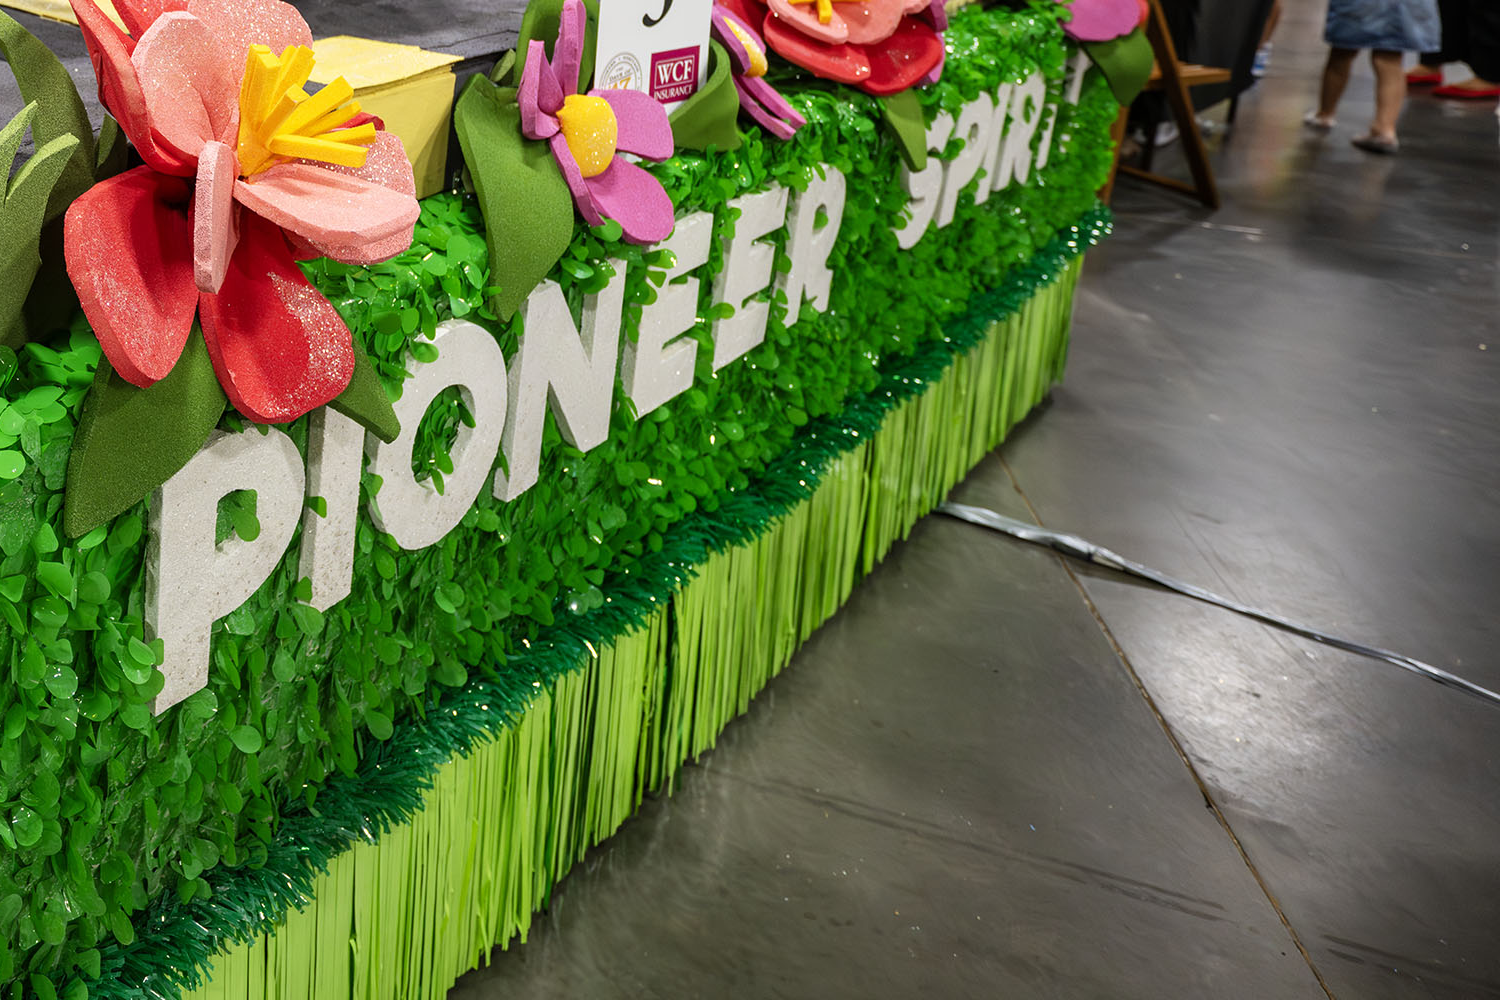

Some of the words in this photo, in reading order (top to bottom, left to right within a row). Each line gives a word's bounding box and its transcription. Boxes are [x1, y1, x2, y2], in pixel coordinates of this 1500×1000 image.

[657, 59, 693, 85] WCF
[654, 84, 693, 101] INSURANCE
[144, 163, 847, 717] PIONEER
[890, 45, 1095, 251] SPIRIT
